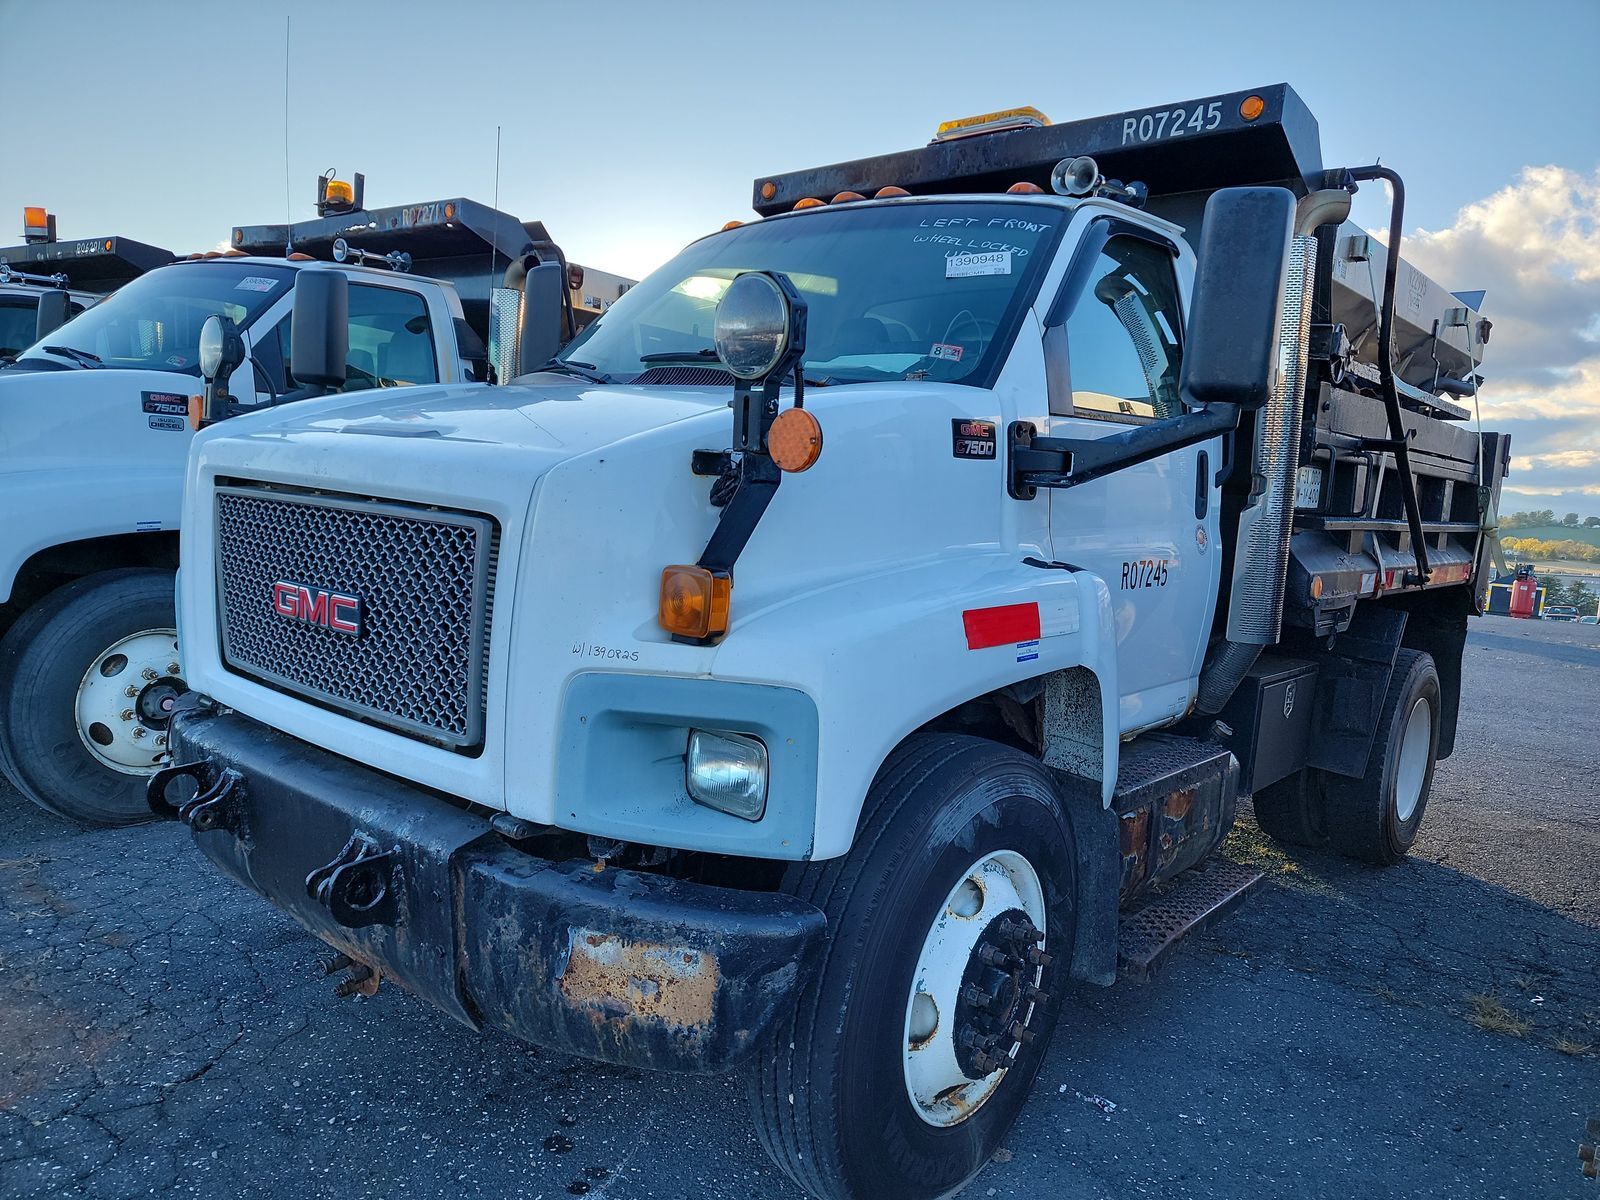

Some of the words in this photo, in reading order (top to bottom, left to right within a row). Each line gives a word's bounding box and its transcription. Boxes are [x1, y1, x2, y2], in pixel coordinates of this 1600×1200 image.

[1121, 101, 1223, 146] R07245
[919, 217, 980, 228] LEFT
[913, 233, 963, 247] WHEEL
[967, 239, 1029, 257] LOCKED
[948, 253, 1004, 268] 1390948
[933, 346, 943, 355] 8
[150, 393, 182, 403] GMC
[145, 402, 187, 414] C7500
[150, 421, 183, 430] DIESEL
[960, 423, 990, 437] GMC
[955, 439, 994, 455] C7500
[1120, 559, 1169, 590] R07245
[274, 581, 359, 635] GMC
